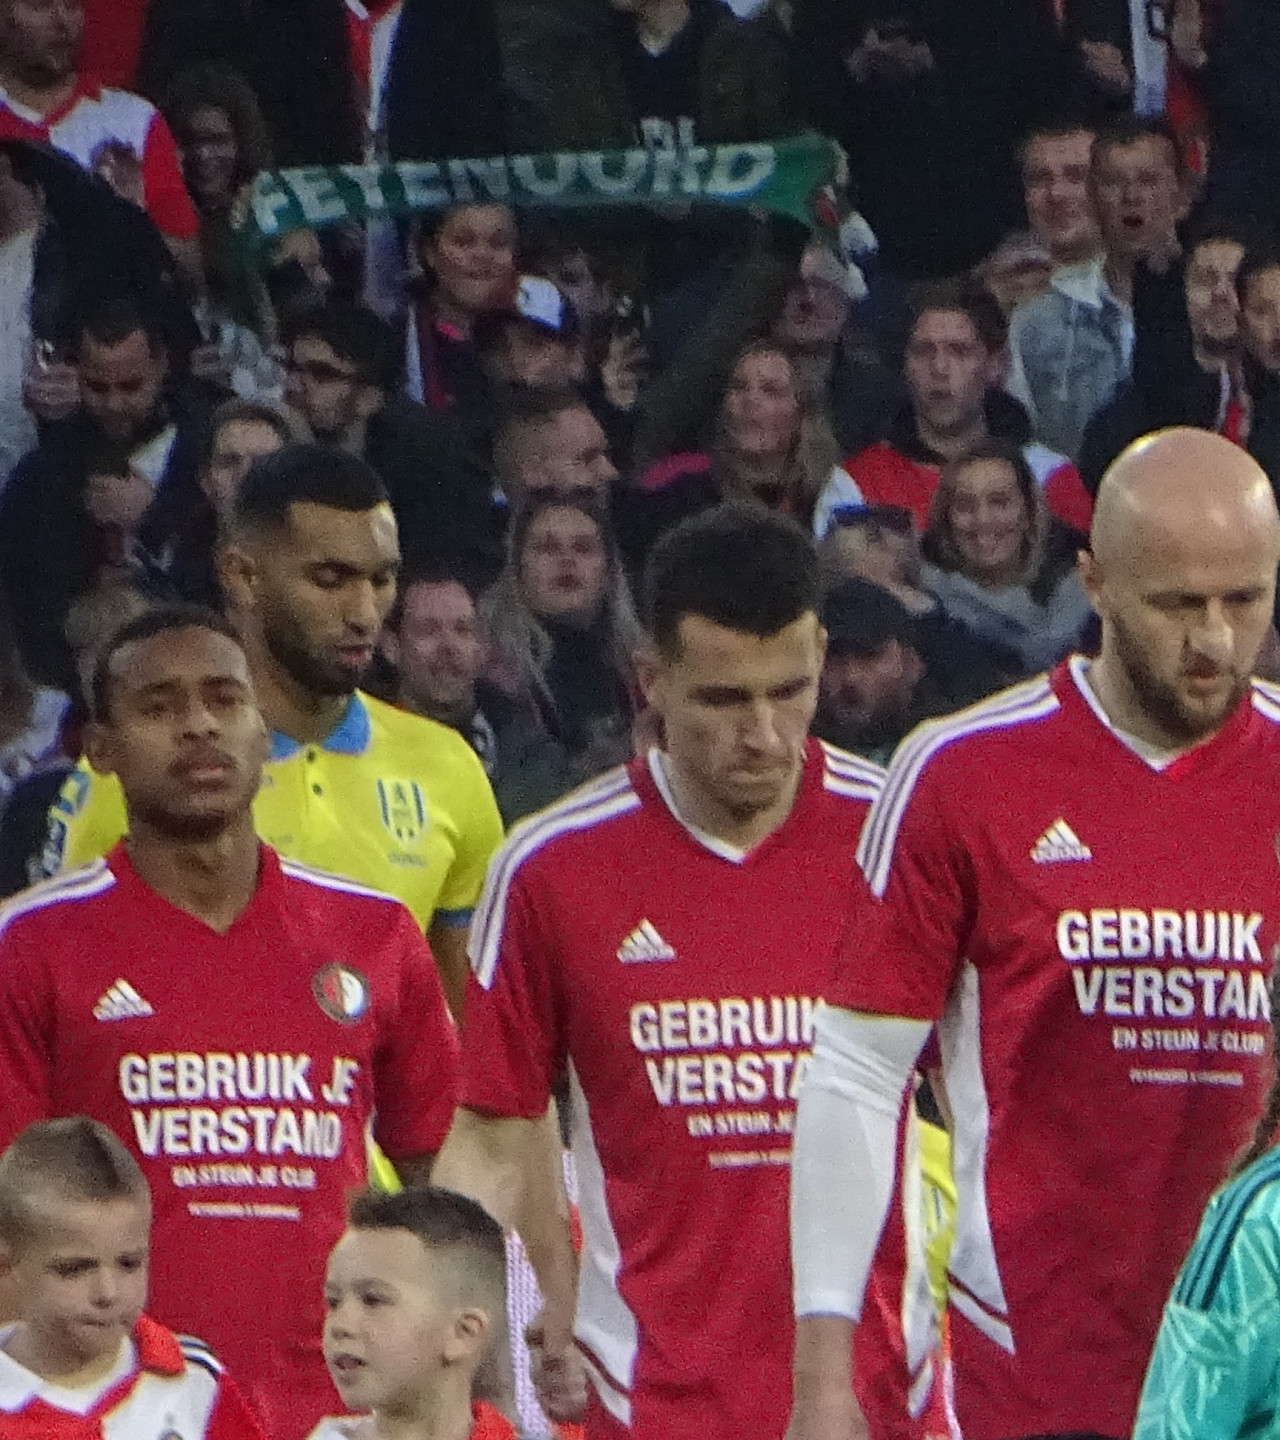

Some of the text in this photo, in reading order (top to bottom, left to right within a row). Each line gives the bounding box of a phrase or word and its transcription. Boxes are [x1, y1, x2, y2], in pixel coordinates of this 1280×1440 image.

[1056, 908, 1265, 964] GEBRUIK
[118, 1052, 361, 1106] GEBRUIK JE
[131, 1106, 344, 1160] VERSTAND
